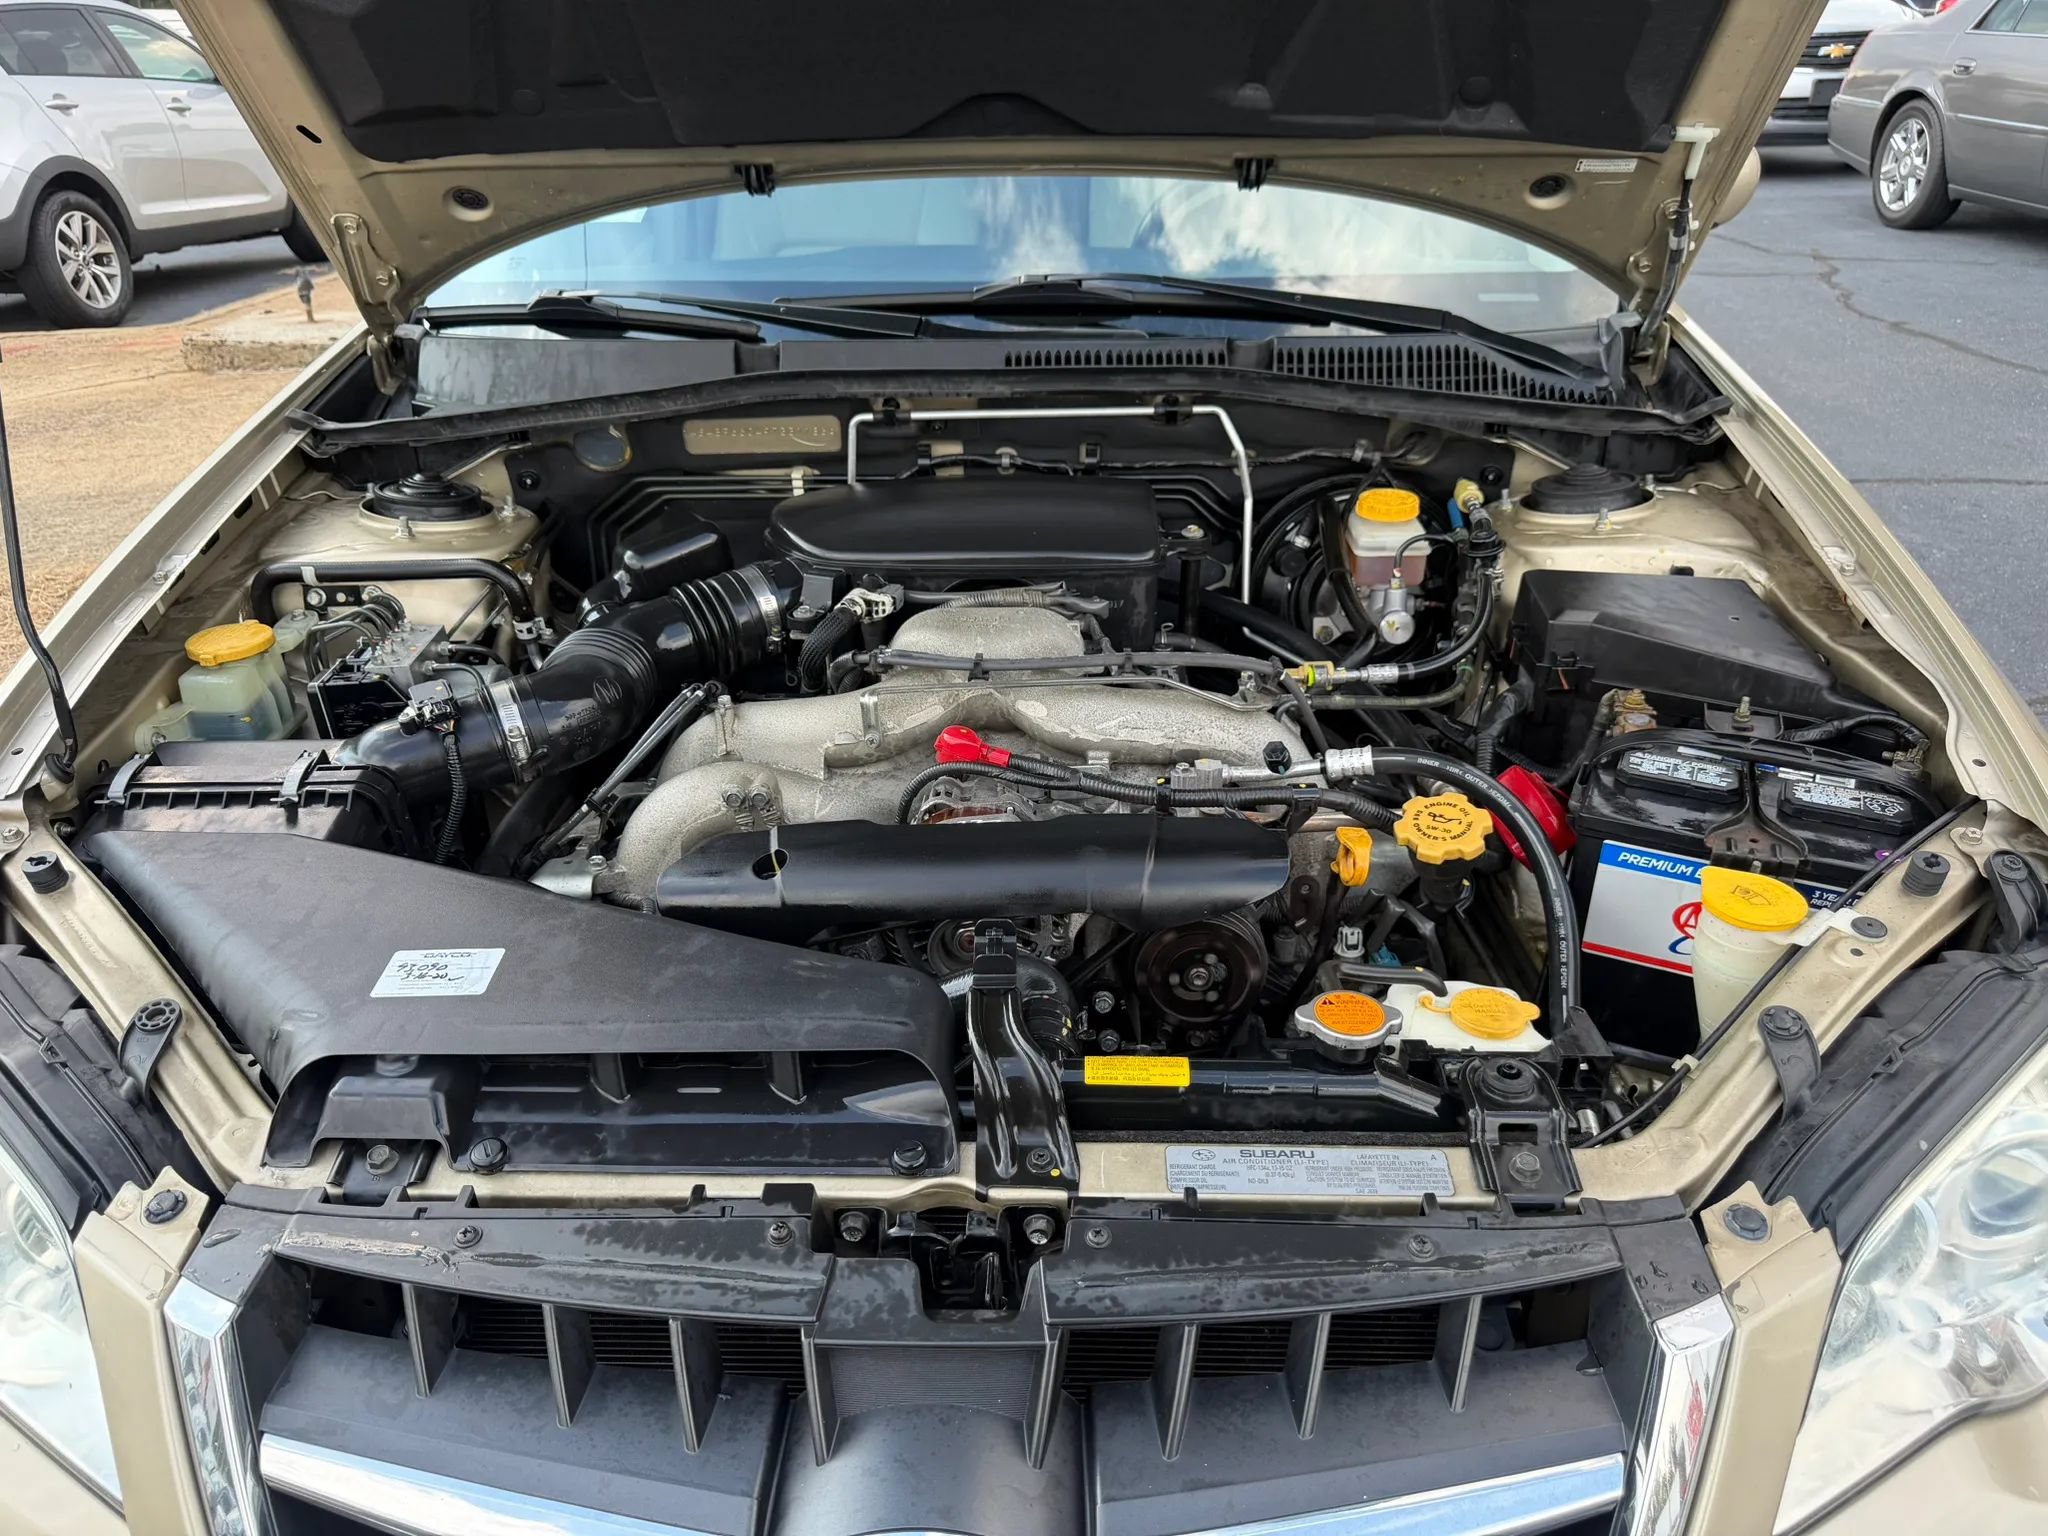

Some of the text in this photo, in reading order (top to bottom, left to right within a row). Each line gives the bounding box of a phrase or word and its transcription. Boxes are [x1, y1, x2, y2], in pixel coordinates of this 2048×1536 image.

[1464, 773, 1489, 790] OUTER
[1423, 801, 1471, 817] ENGINE OIL
[1413, 810, 1423, 821] SEE
[1449, 820, 1474, 841] MANUAL
[1618, 851, 1695, 876] PREMIUM
[1812, 890, 1821, 898] 3
[1559, 940, 1568, 963] OUTER
[1238, 1158, 1292, 1166] CONDITIONER
[1239, 1149, 1315, 1159] SUBARU
